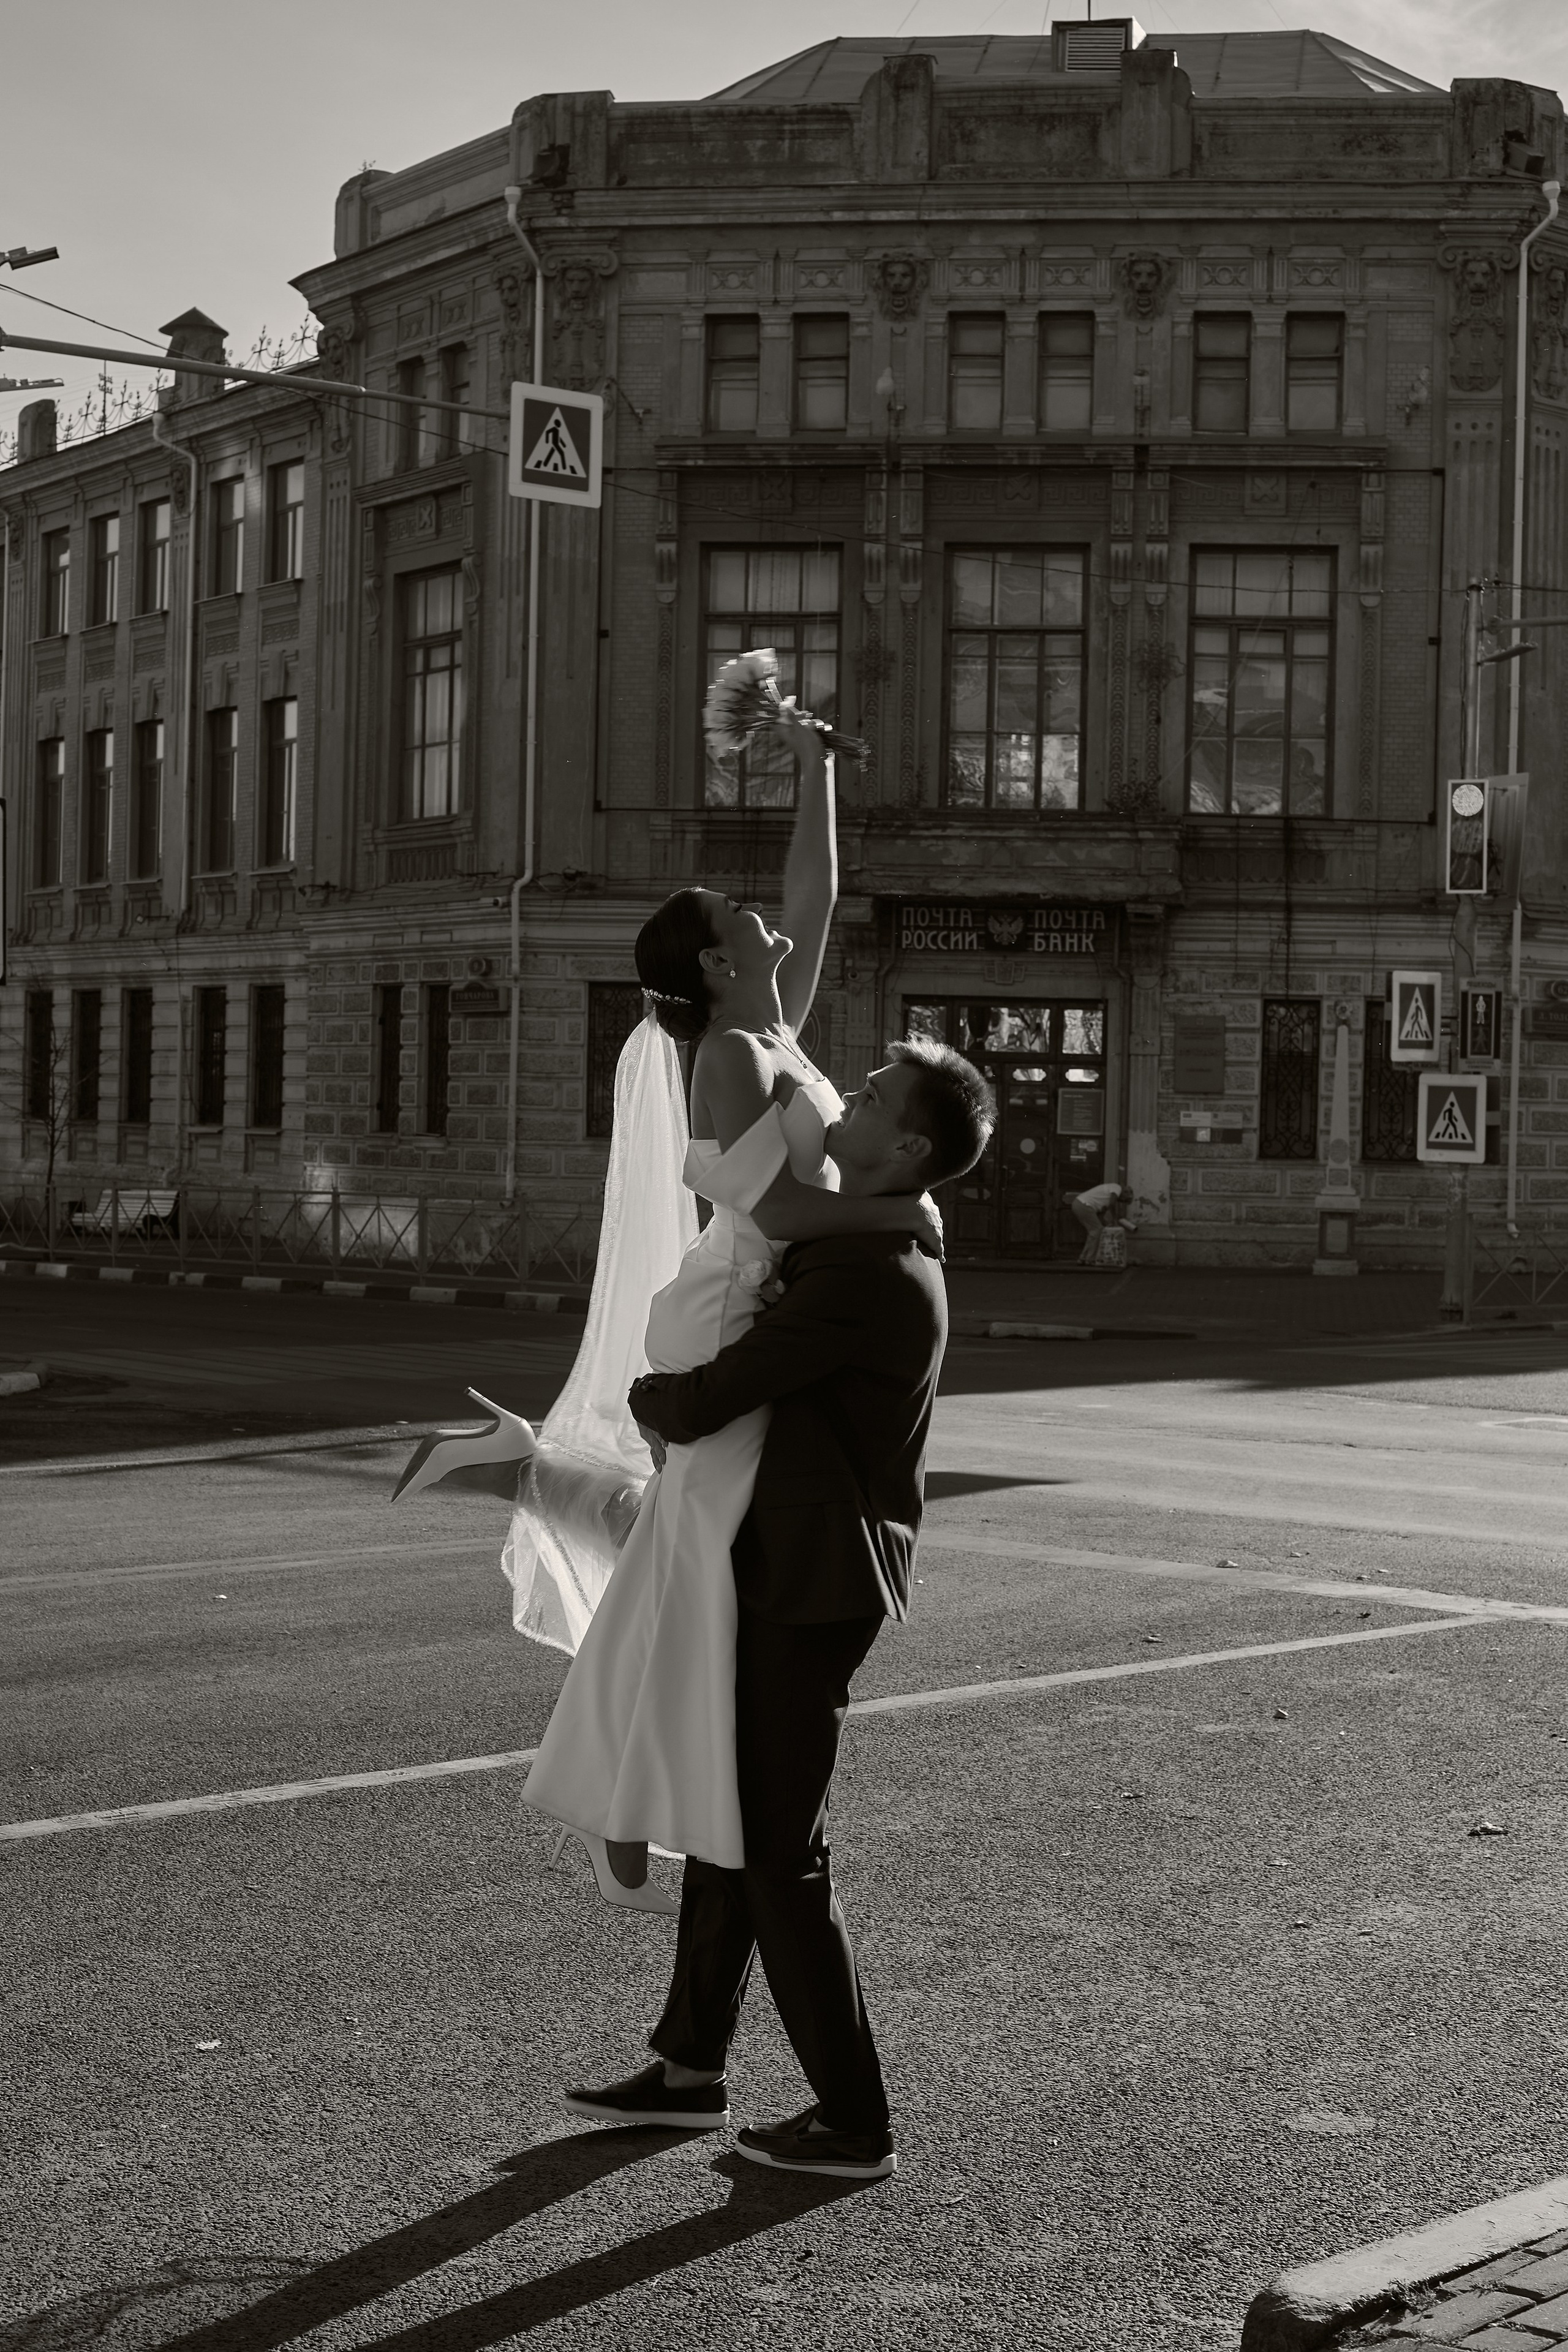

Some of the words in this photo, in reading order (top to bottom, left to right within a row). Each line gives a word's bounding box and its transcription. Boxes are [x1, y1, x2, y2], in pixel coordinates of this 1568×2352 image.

[902, 907, 973, 927] ПОЧТА
[1034, 909, 1105, 930] ПОЧТА
[902, 930, 978, 951] РОССИИ
[1033, 932, 1095, 952] БАНК
